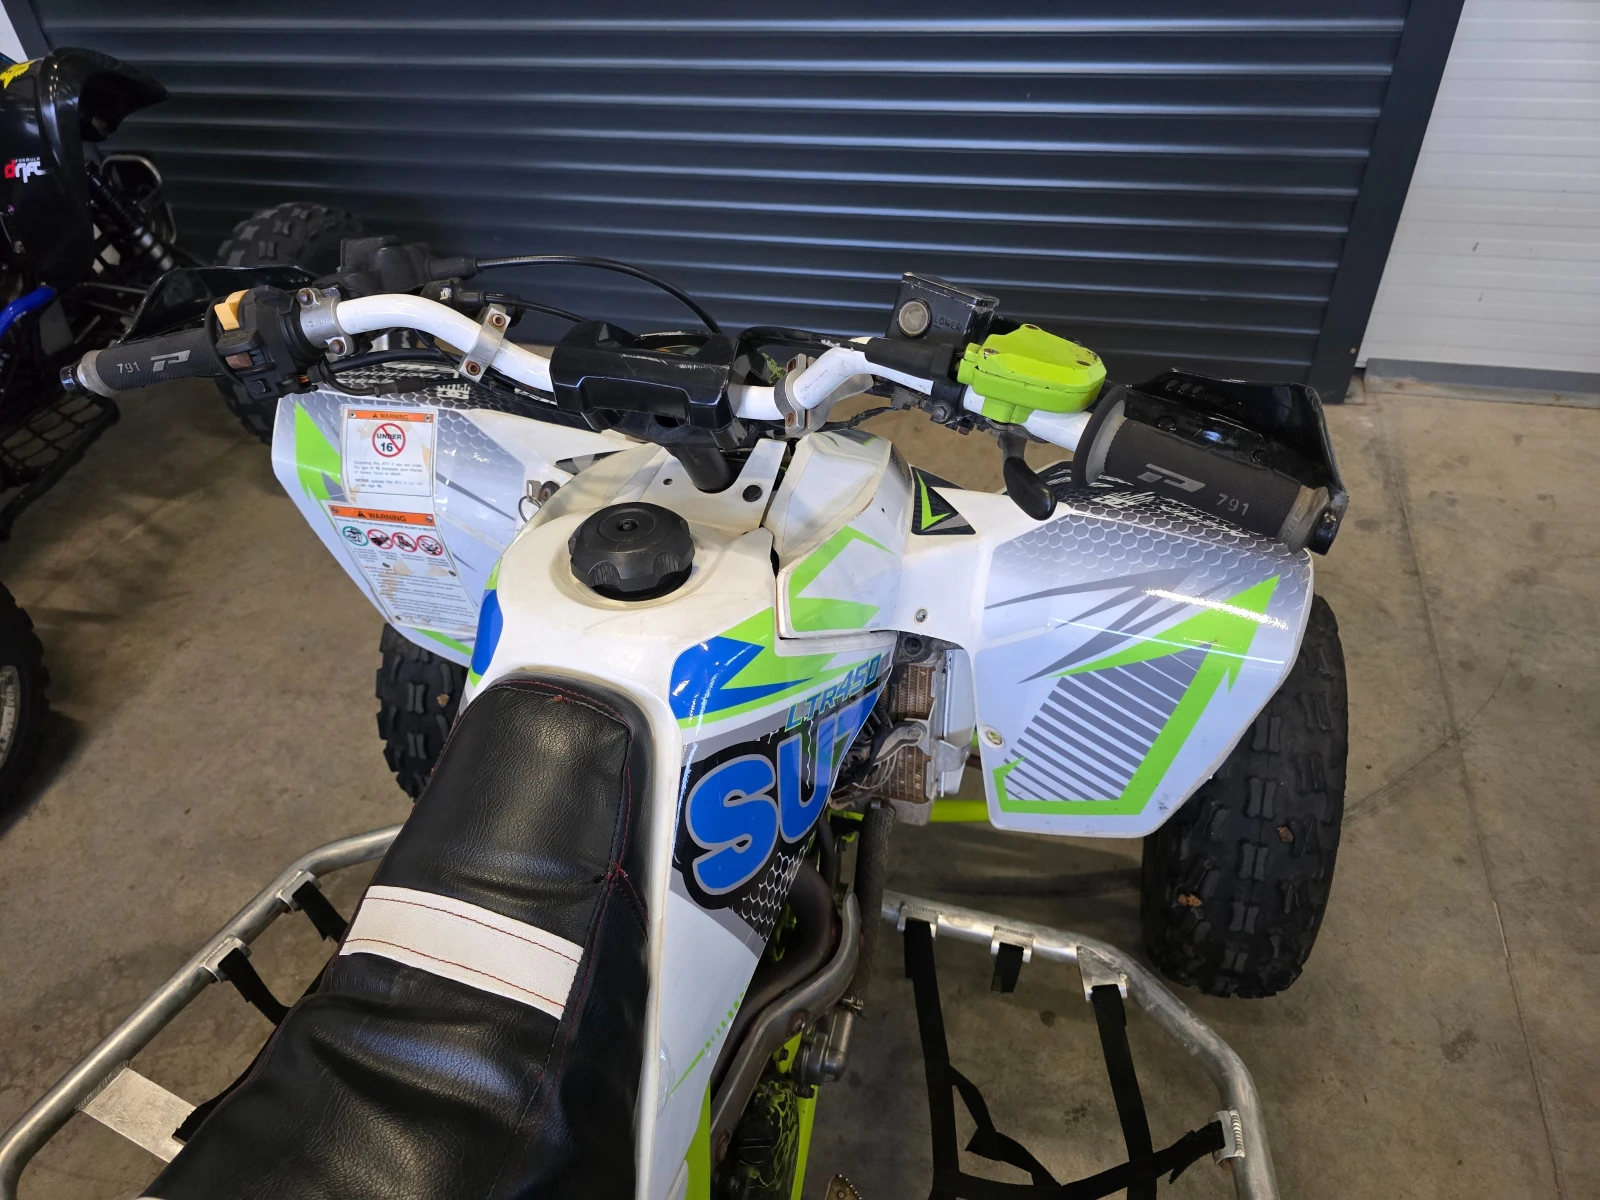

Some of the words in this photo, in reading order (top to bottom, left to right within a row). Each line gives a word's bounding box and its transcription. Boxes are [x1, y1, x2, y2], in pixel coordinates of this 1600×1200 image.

[934, 314, 963, 331] LOWER
[117, 361, 140, 374] 791
[381, 442, 393, 452] 16
[1217, 492, 1250, 516] 791
[368, 512, 406, 522] WARNING
[784, 653, 882, 732] LTR450
